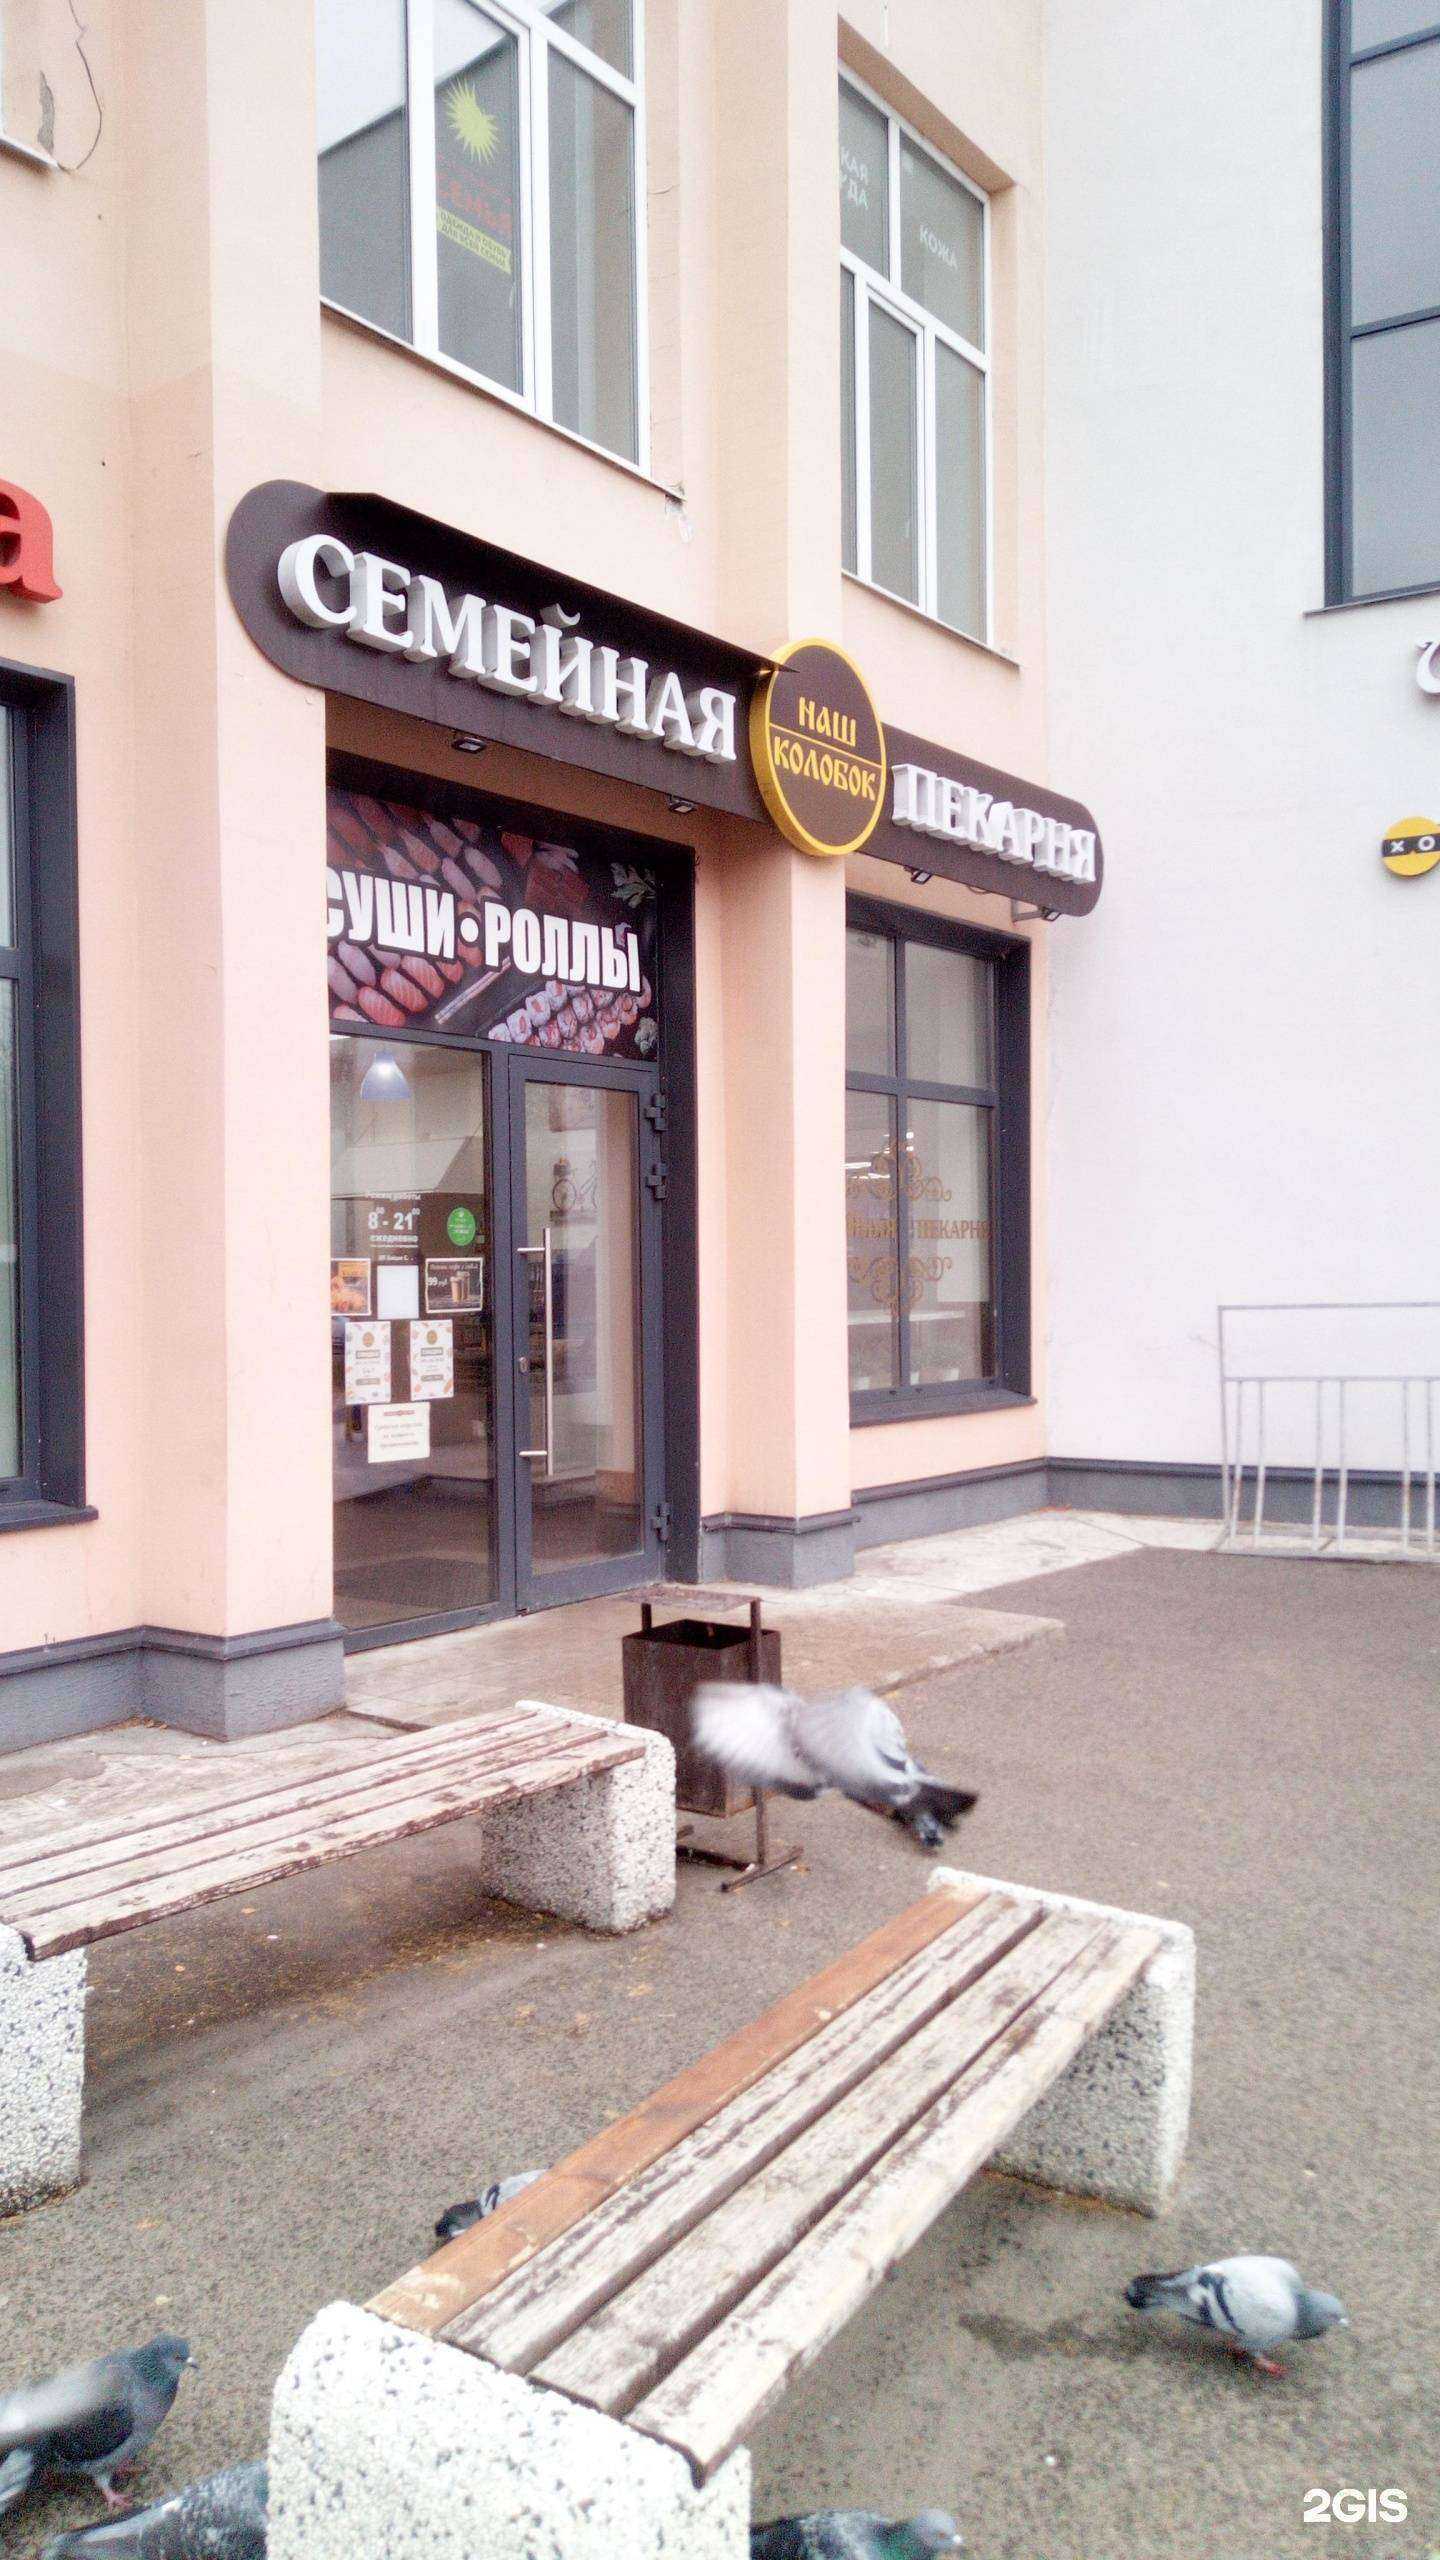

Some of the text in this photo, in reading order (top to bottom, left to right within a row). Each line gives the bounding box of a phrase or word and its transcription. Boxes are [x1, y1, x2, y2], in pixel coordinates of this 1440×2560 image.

[920, 222, 959, 272] КОЖА
[277, 533, 738, 764] СЕМЕЙНАЯ
[798, 696, 857, 747] НАШ
[773, 735, 876, 801] КОЛОБОК
[891, 763, 1096, 884] ПЕКАРНЯ
[484, 901, 641, 992] РОЛЛЫ
